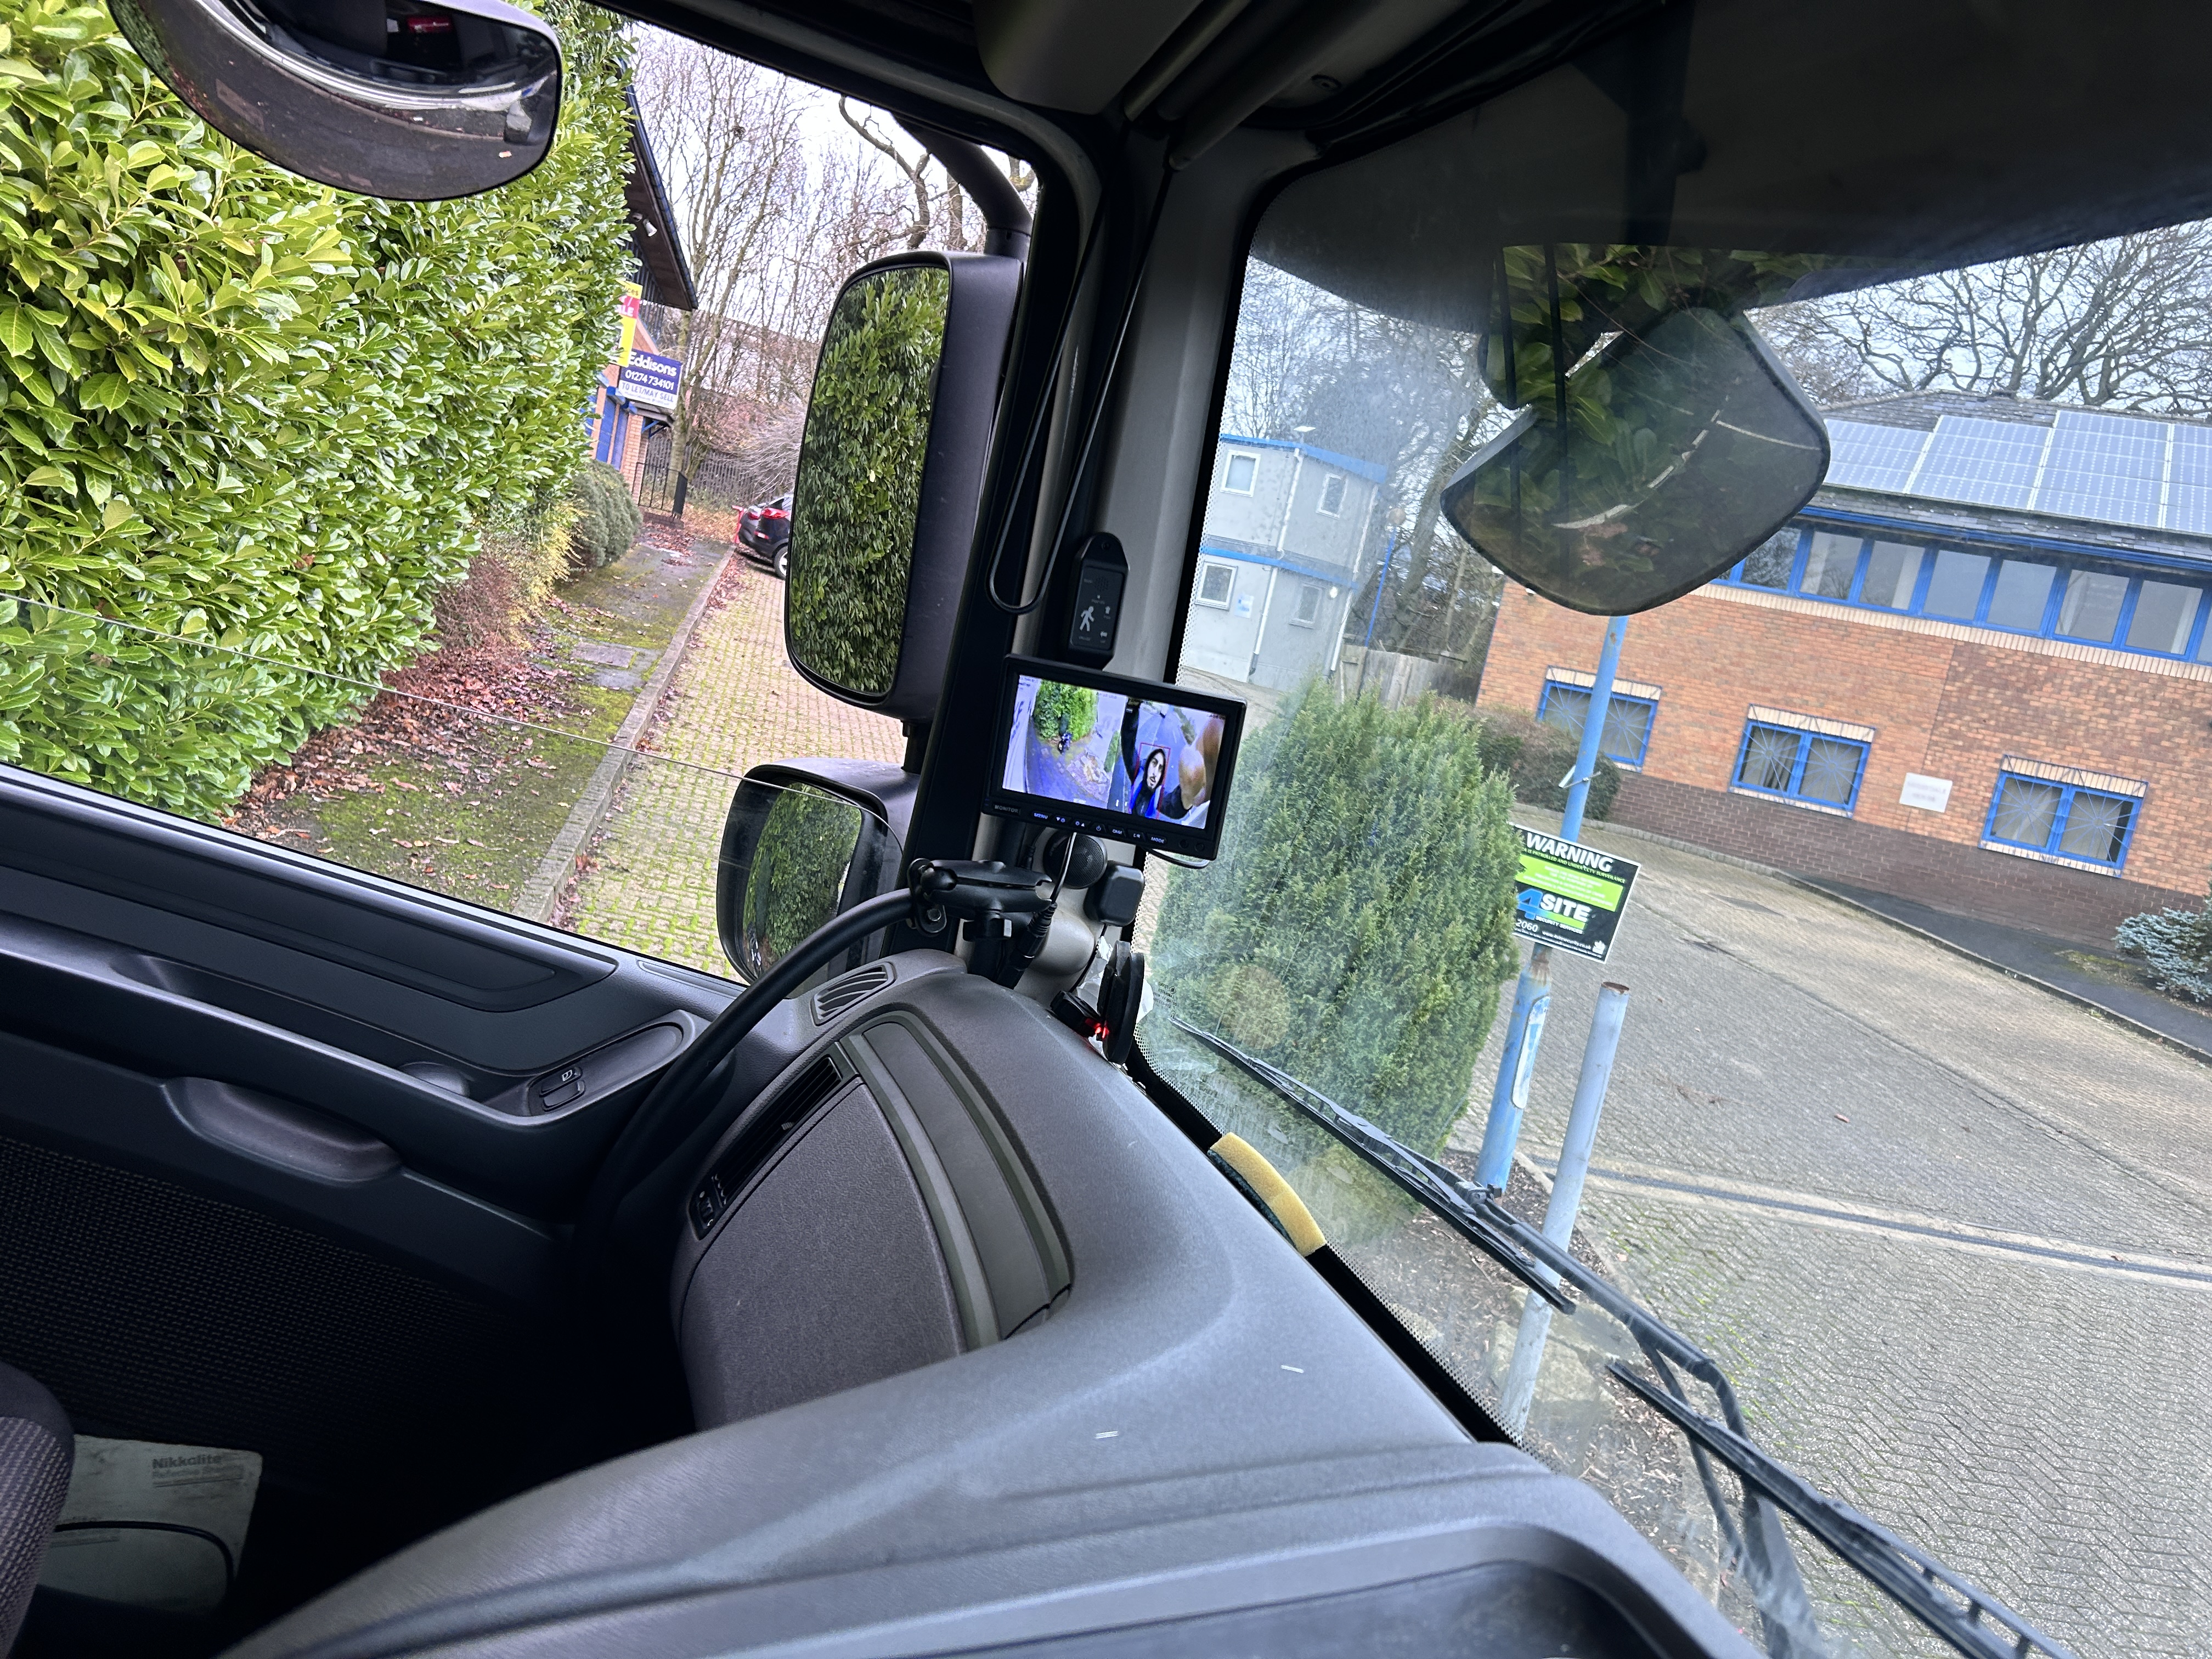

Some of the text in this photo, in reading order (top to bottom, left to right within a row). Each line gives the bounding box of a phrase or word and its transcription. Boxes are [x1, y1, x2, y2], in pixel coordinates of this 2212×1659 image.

[629, 351, 677, 377] Eddisons
[625, 369, 674, 391] 01274 734101
[622, 382, 630, 391] TO
[660, 392, 674, 403] SELL
[994, 805, 1019, 814] MONITOR
[1526, 832, 1613, 872] WARNING
[1532, 850, 1558, 862] PATROLLED
[1558, 857, 1567, 866] AND
[1567, 861, 1583, 871] UNDER
[1517, 888, 1592, 923] 4SITE
[1515, 919, 1538, 933] 2060
[1536, 915, 1583, 934] SECURITY SERVICES
